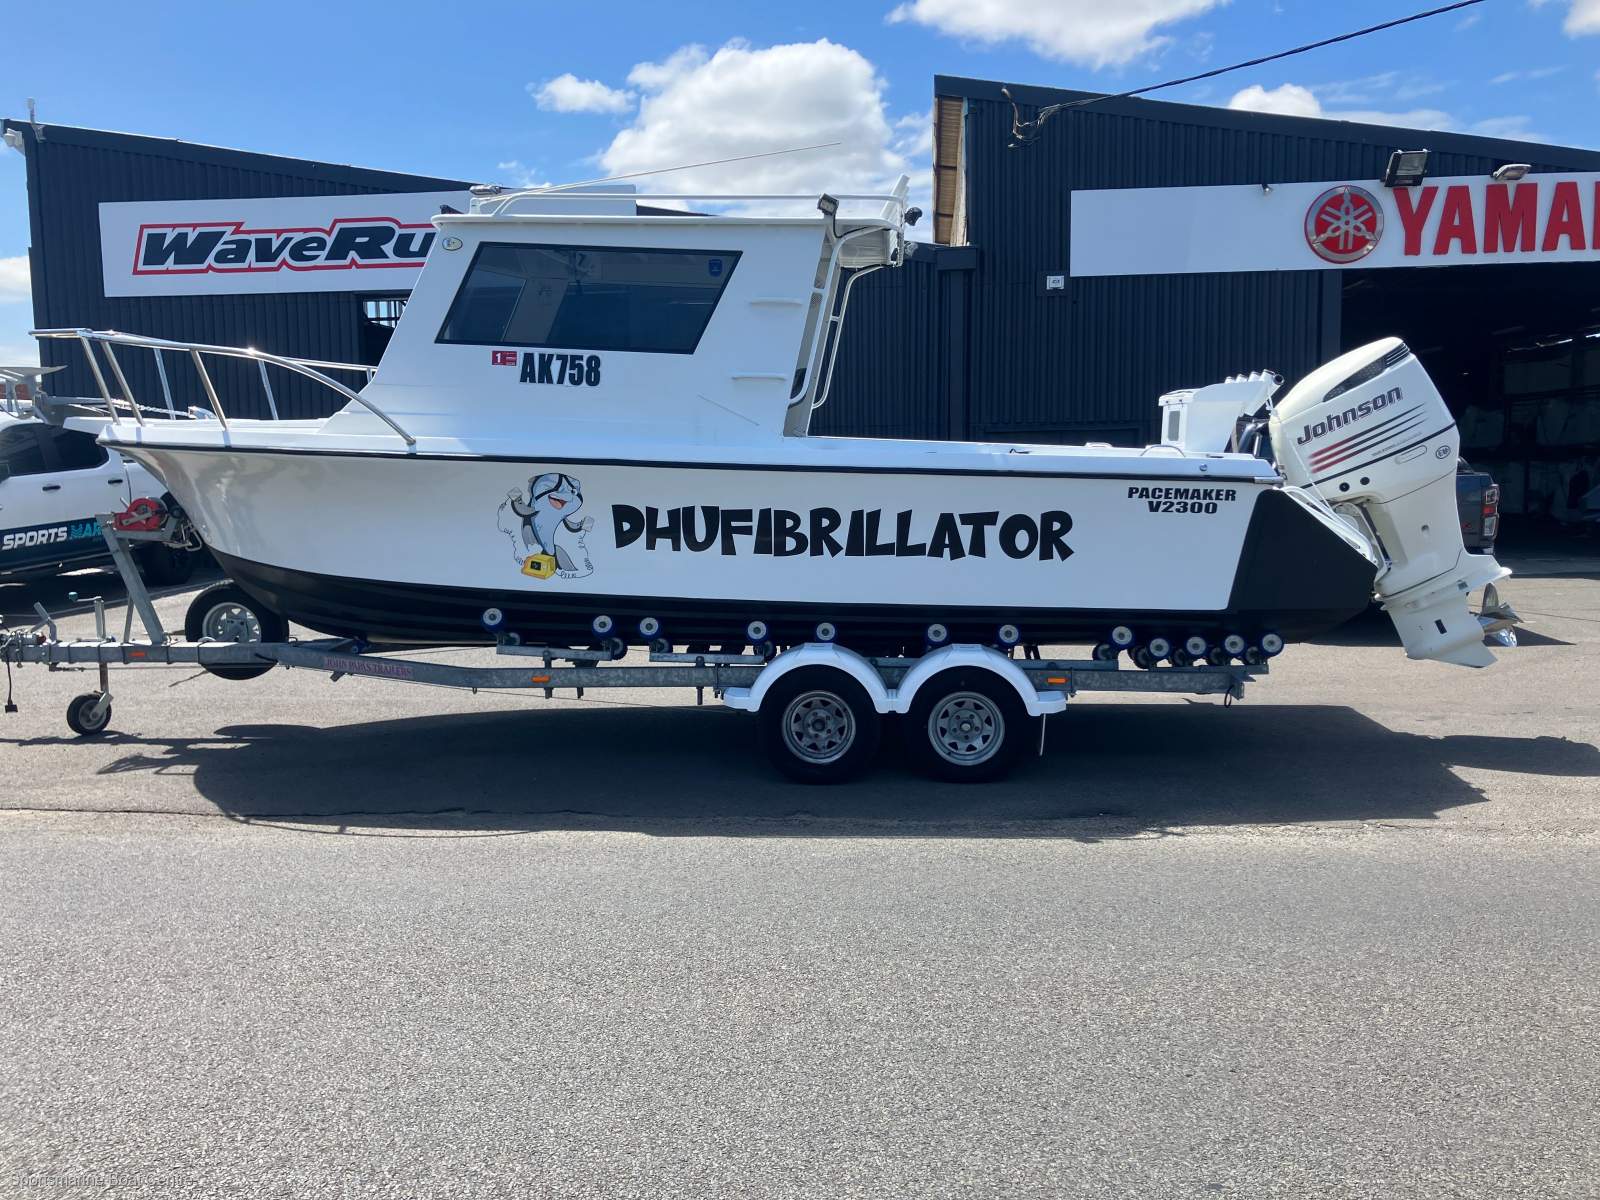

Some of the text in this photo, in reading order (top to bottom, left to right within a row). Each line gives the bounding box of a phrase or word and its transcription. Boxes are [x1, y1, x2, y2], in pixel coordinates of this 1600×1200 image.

[1392, 181, 1600, 256] YAMA
[519, 352, 601, 387] AK758
[1297, 386, 1403, 445] Johnson
[1127, 486, 1237, 501] PACEMAKER
[1148, 500, 1218, 514] V2300
[2, 526, 68, 550] SPORTS
[611, 504, 1075, 562] DHUFIBRILLATOR
